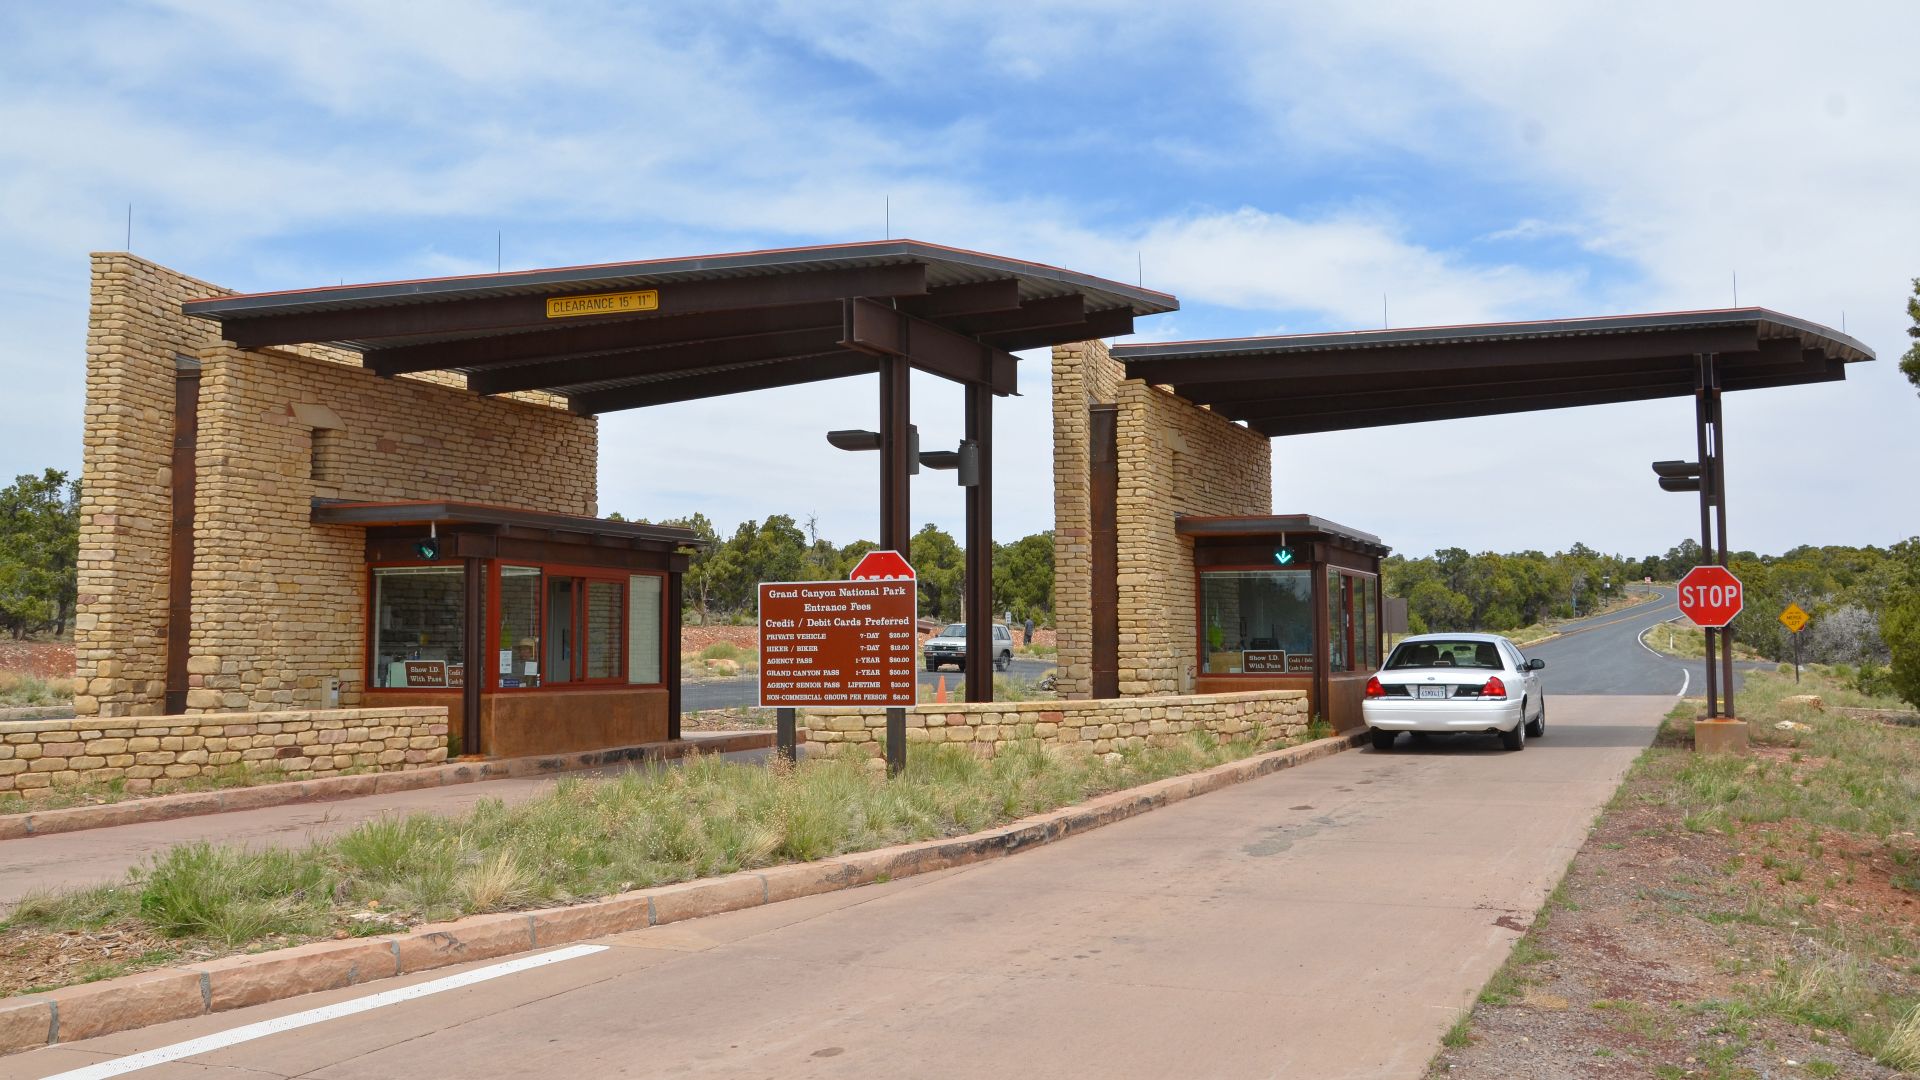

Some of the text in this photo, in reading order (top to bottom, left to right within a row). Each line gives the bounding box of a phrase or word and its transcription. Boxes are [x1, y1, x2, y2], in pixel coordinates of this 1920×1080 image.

[553, 297, 614, 313] CLEARANCE
[769, 586, 906, 600] Grand Canyon National Park
[1682, 585, 1737, 608] STOP
[804, 602, 871, 612] Entrance Fees
[765, 616, 909, 628] Credit / Debit Cards Preferred
[766, 657, 795, 665] AGENCY
